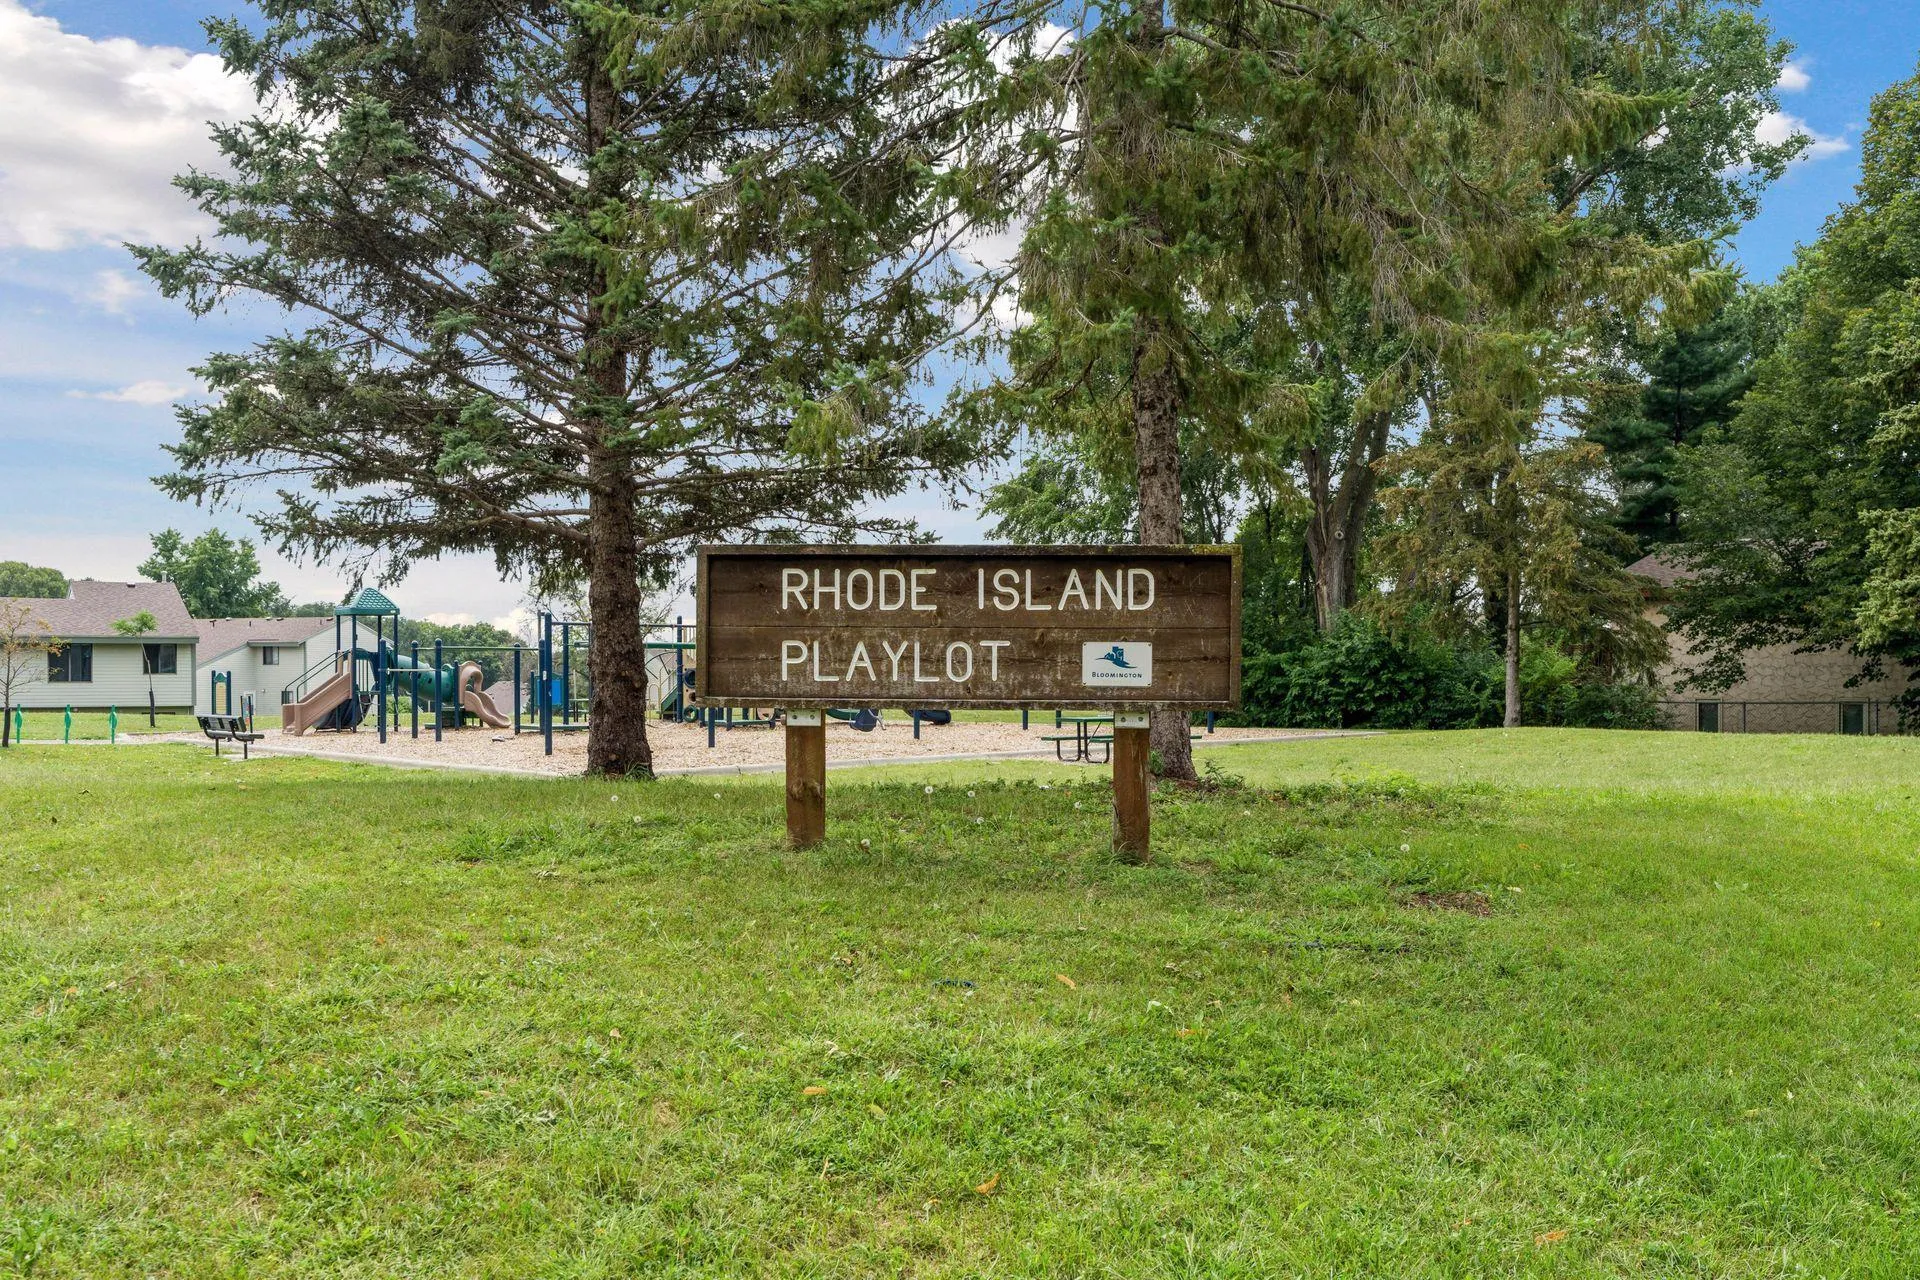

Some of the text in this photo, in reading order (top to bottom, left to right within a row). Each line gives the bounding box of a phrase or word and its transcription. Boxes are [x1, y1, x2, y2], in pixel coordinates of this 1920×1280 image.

[781, 568, 1156, 611] RHODE ISLAND
[781, 639, 1011, 682] PLAYLOT
[1091, 671, 1143, 679] BLOOMINGTON
